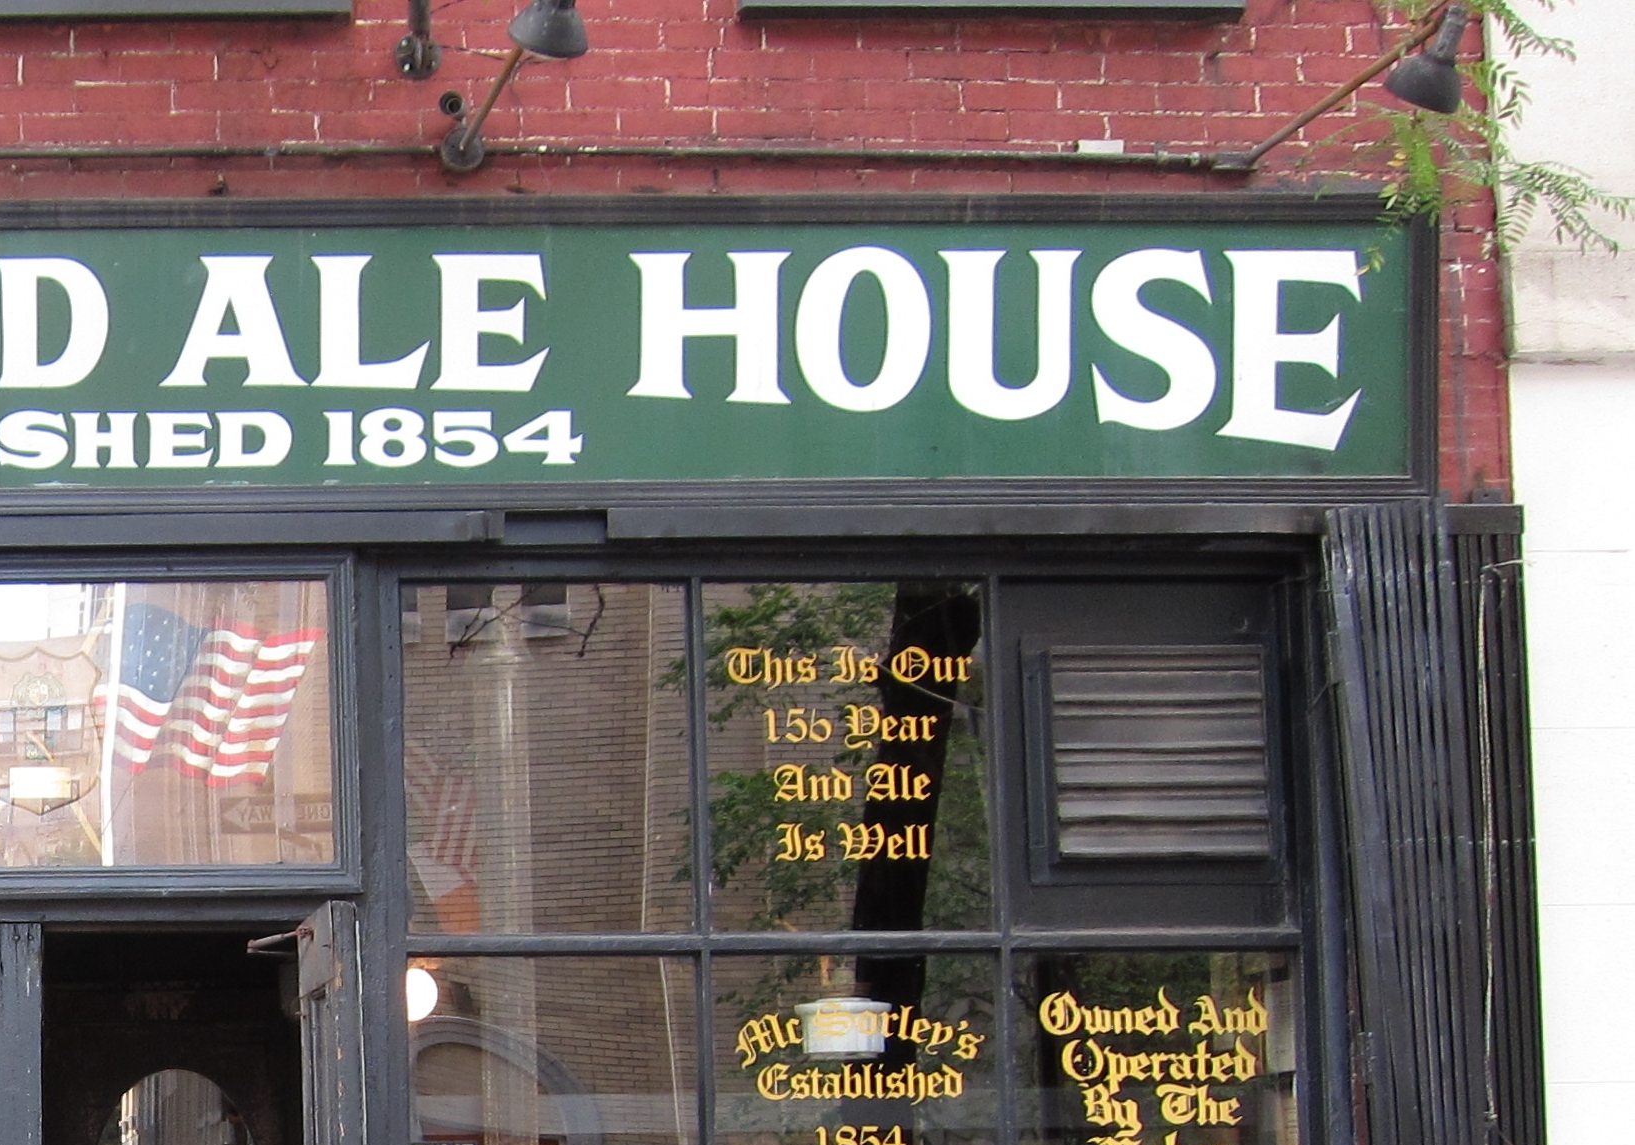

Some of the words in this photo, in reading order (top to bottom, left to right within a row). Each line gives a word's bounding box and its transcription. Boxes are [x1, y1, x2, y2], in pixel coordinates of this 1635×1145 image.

[160, 254, 552, 392] ALE
[626, 245, 1362, 451] HOUSE
[323, 409, 582, 469] 1854
[725, 646, 817, 690] This
[829, 645, 879, 684] Is
[891, 645, 972, 684] Our
[765, 703, 832, 743] 156
[844, 704, 937, 749] Year
[774, 763, 853, 802] And
[866, 763, 931, 802] Ale
[775, 823, 825, 862] Is
[837, 822, 931, 861] Well
[735, 1013, 804, 1068] Mc
[811, 1001, 985, 1060] Sorley's
[1039, 987, 1180, 1037] Owned
[1188, 987, 1269, 1036] And
[1061, 1038, 1258, 1083] Operated
[756, 1063, 964, 1106] Established
[1082, 1083, 1143, 1138] By
[1155, 1081, 1243, 1127] The
